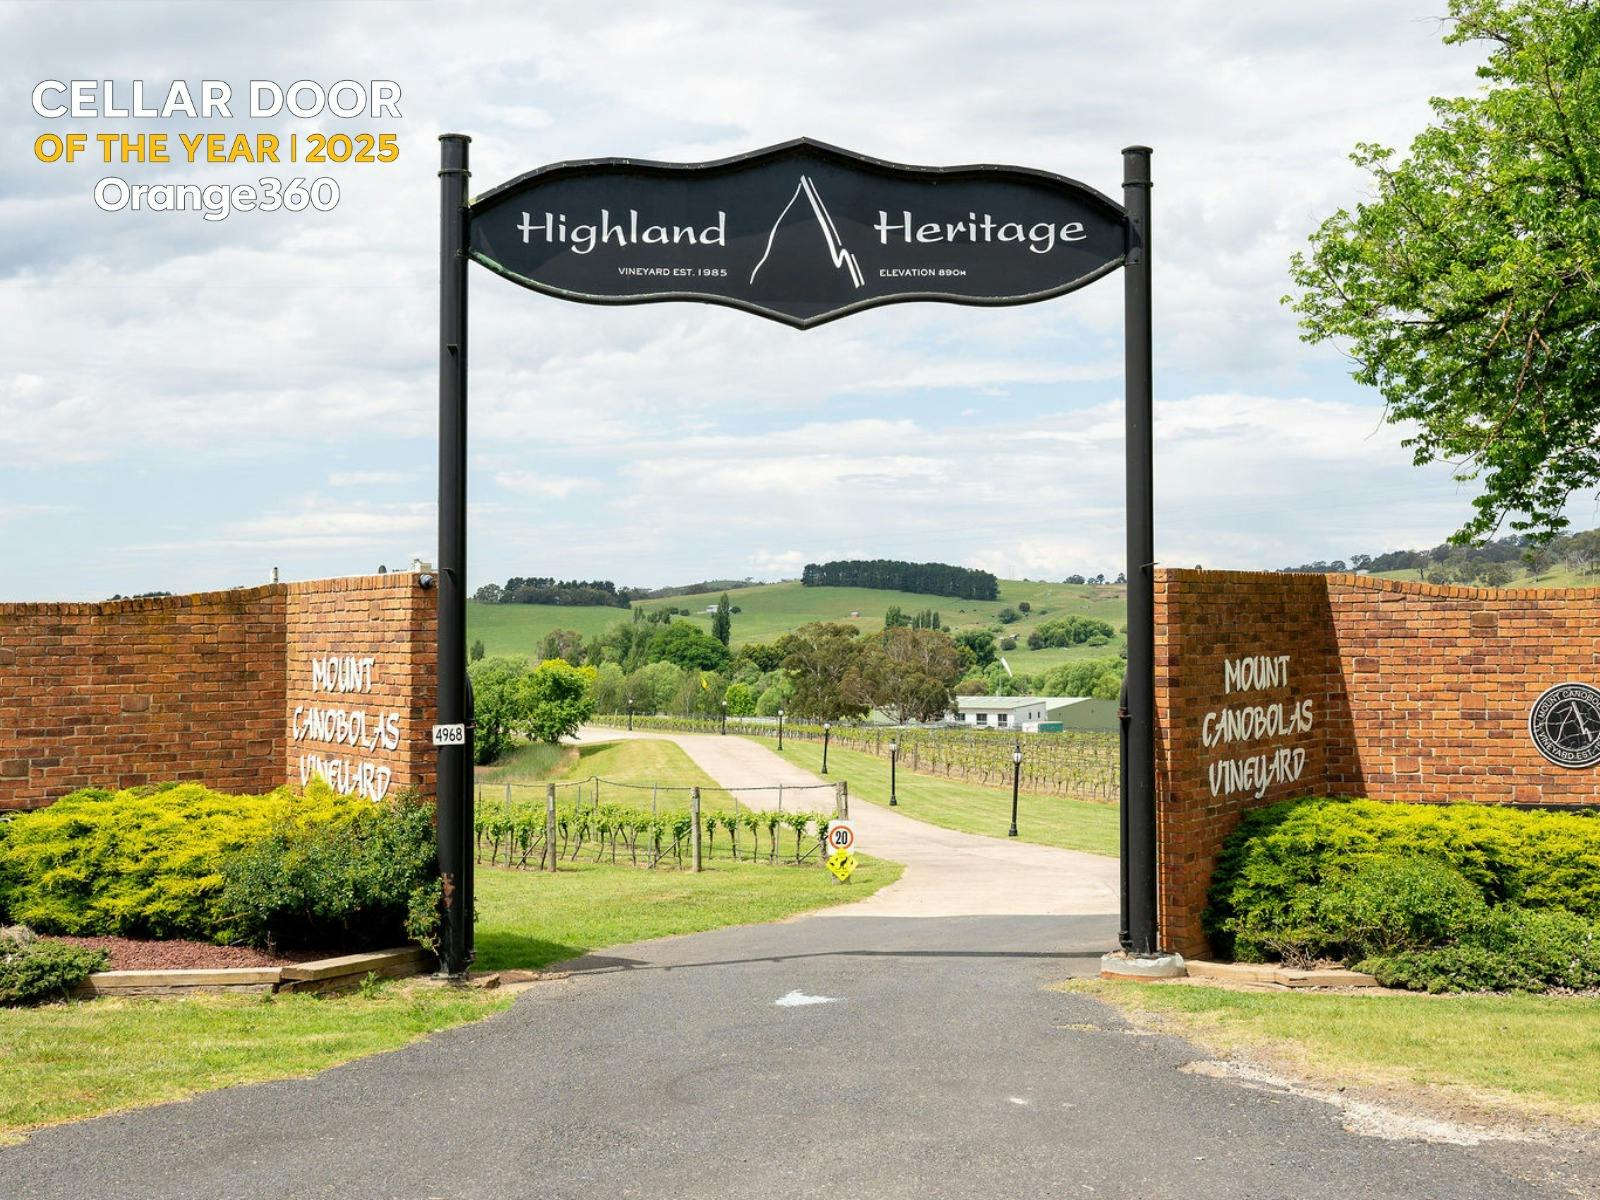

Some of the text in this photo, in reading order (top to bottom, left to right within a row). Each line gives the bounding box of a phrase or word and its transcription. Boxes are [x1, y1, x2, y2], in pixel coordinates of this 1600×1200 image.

[516, 208, 1087, 255] Highland Heritage
[618, 267, 728, 277] VINEYARD EST. 1985
[879, 268, 936, 277] ELEVATION
[312, 655, 375, 694] MOUNT
[1224, 655, 1290, 694] MOUNT
[1202, 699, 1313, 748] CANOBOLAS
[1538, 692, 1561, 721] MOUNT
[292, 705, 400, 753] CANOBOLAS
[435, 727, 463, 741] 4968
[1538, 731, 1574, 759] VINEYARD
[1208, 747, 1306, 799] VINEYARD
[835, 830, 848, 845] 20
